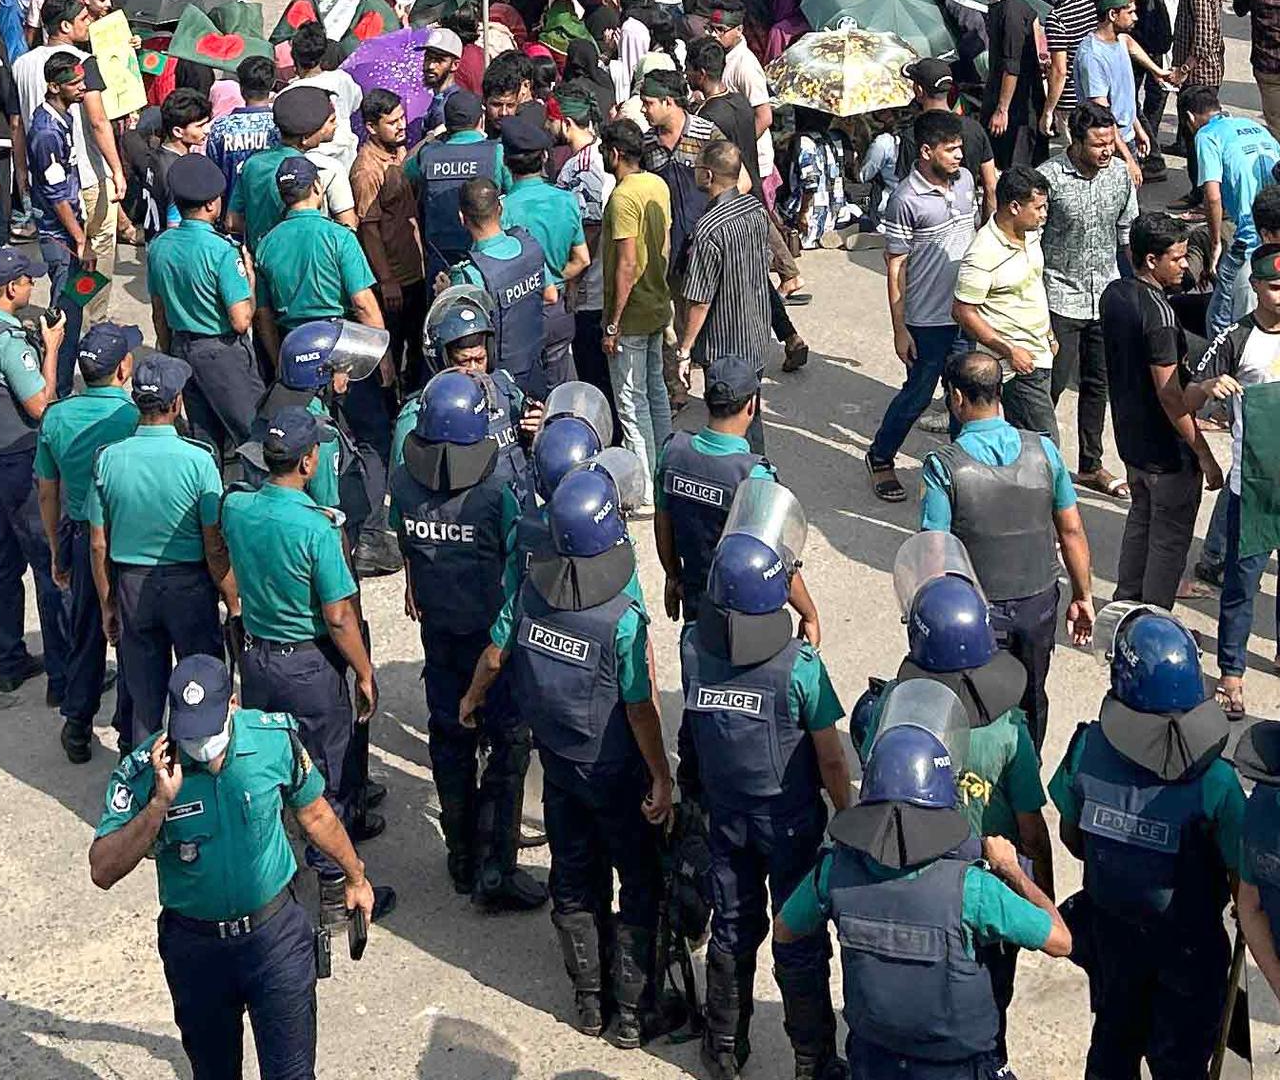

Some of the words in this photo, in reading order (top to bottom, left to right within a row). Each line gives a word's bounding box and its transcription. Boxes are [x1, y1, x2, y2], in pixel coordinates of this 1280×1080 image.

[223, 131, 271, 151] RAHUL
[433, 161, 478, 176] POLICE
[506, 272, 542, 303] POLICE
[677, 480, 718, 501] POLICE
[404, 518, 475, 543] POLICE
[534, 629, 582, 656] POLICE
[703, 694, 753, 709] POLICE
[1100, 811, 1161, 841] POLICE
